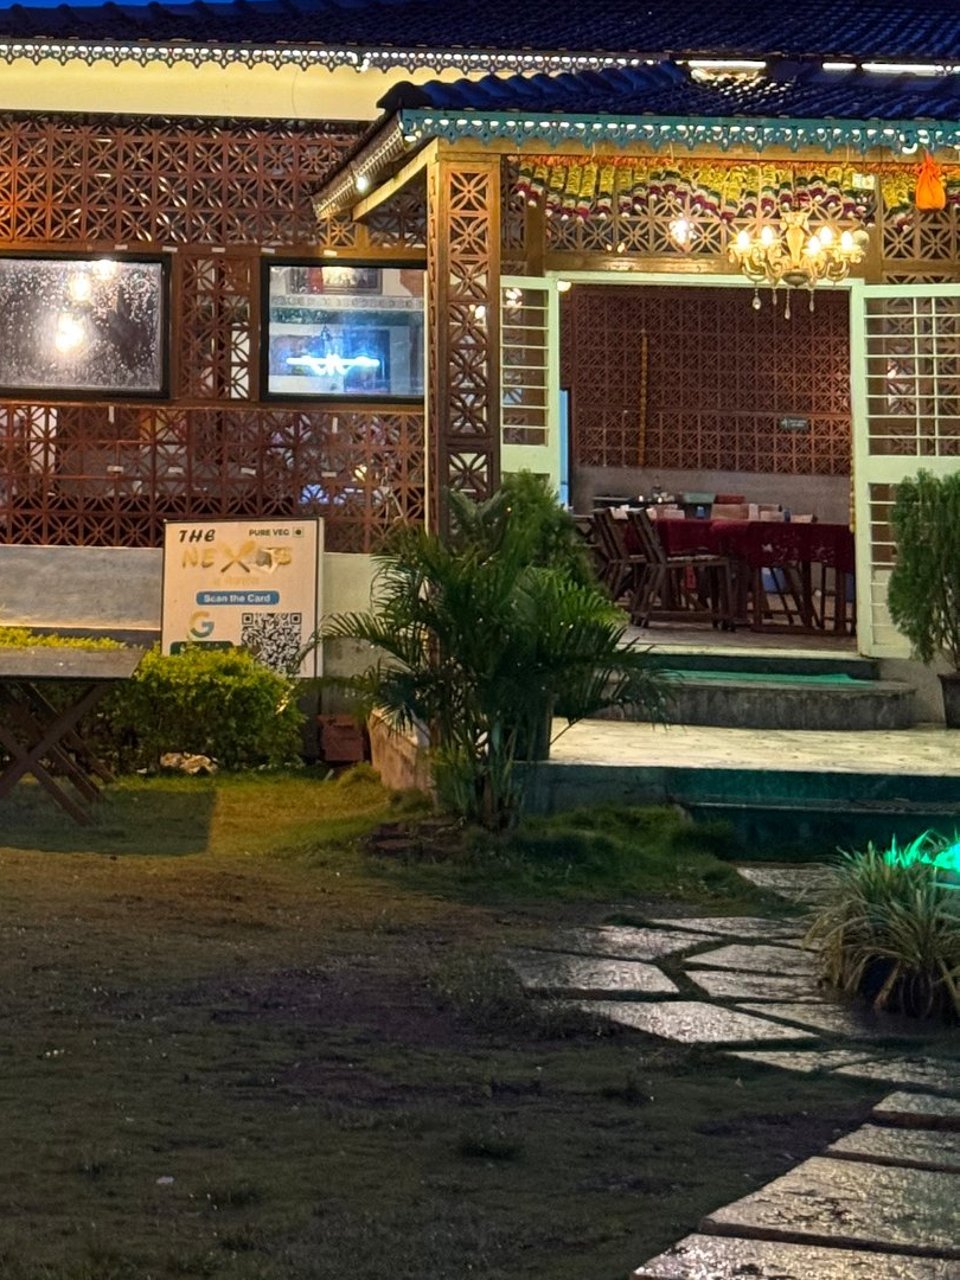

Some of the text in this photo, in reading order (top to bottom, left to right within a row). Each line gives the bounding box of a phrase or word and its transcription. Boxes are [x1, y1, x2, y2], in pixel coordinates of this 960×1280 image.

[179, 529, 216, 543] THE
[203, 594, 271, 602] Scan the Card
